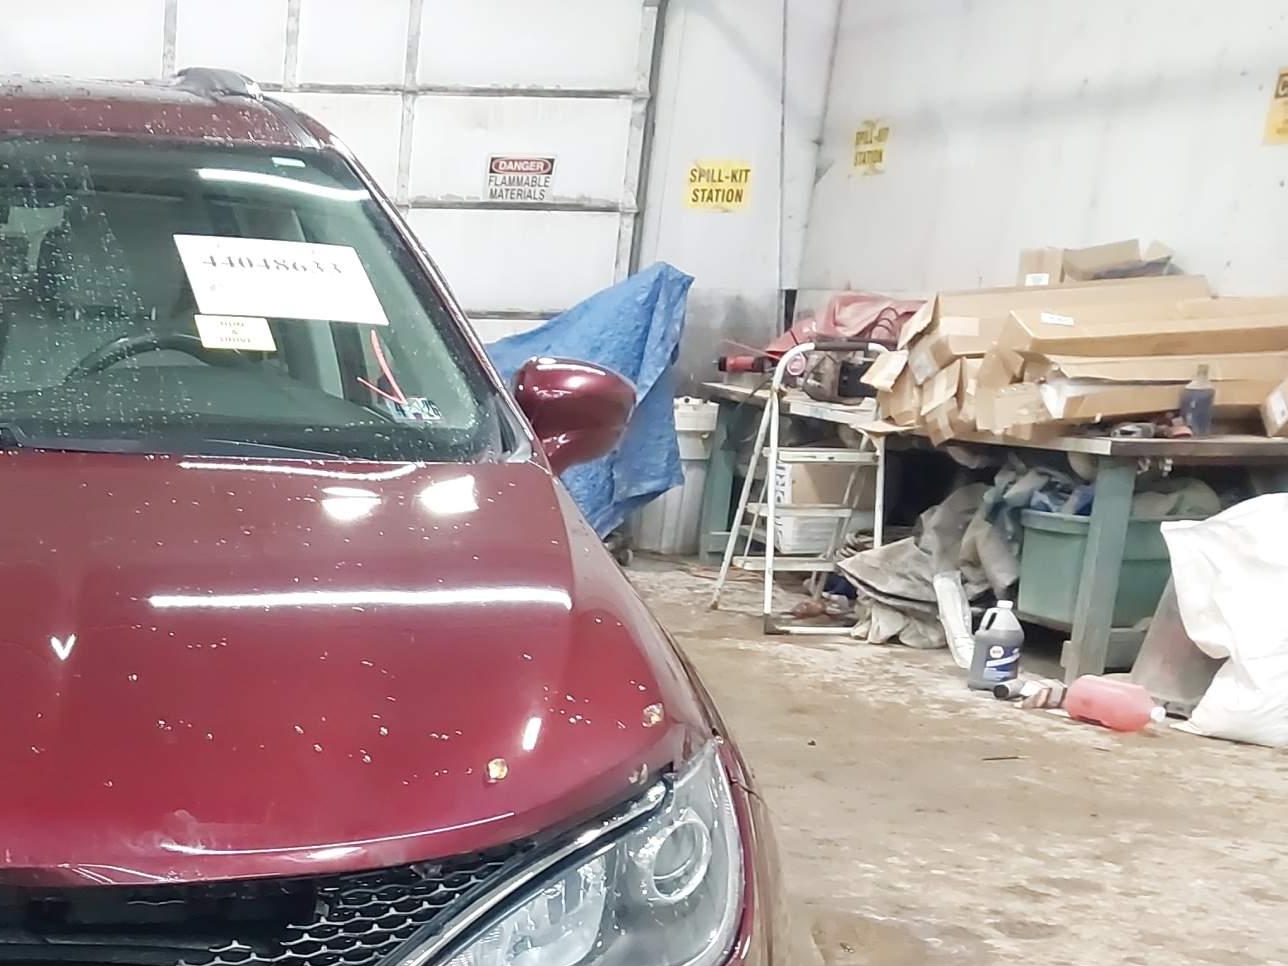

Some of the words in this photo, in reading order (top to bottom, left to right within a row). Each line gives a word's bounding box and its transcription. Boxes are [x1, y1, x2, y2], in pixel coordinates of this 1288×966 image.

[498, 160, 545, 171] DANGER
[488, 175, 551, 187] FLAMMABLE
[690, 168, 751, 183] SPILL-KIT
[489, 188, 546, 200] MATERIALS
[692, 188, 744, 203] STATION
